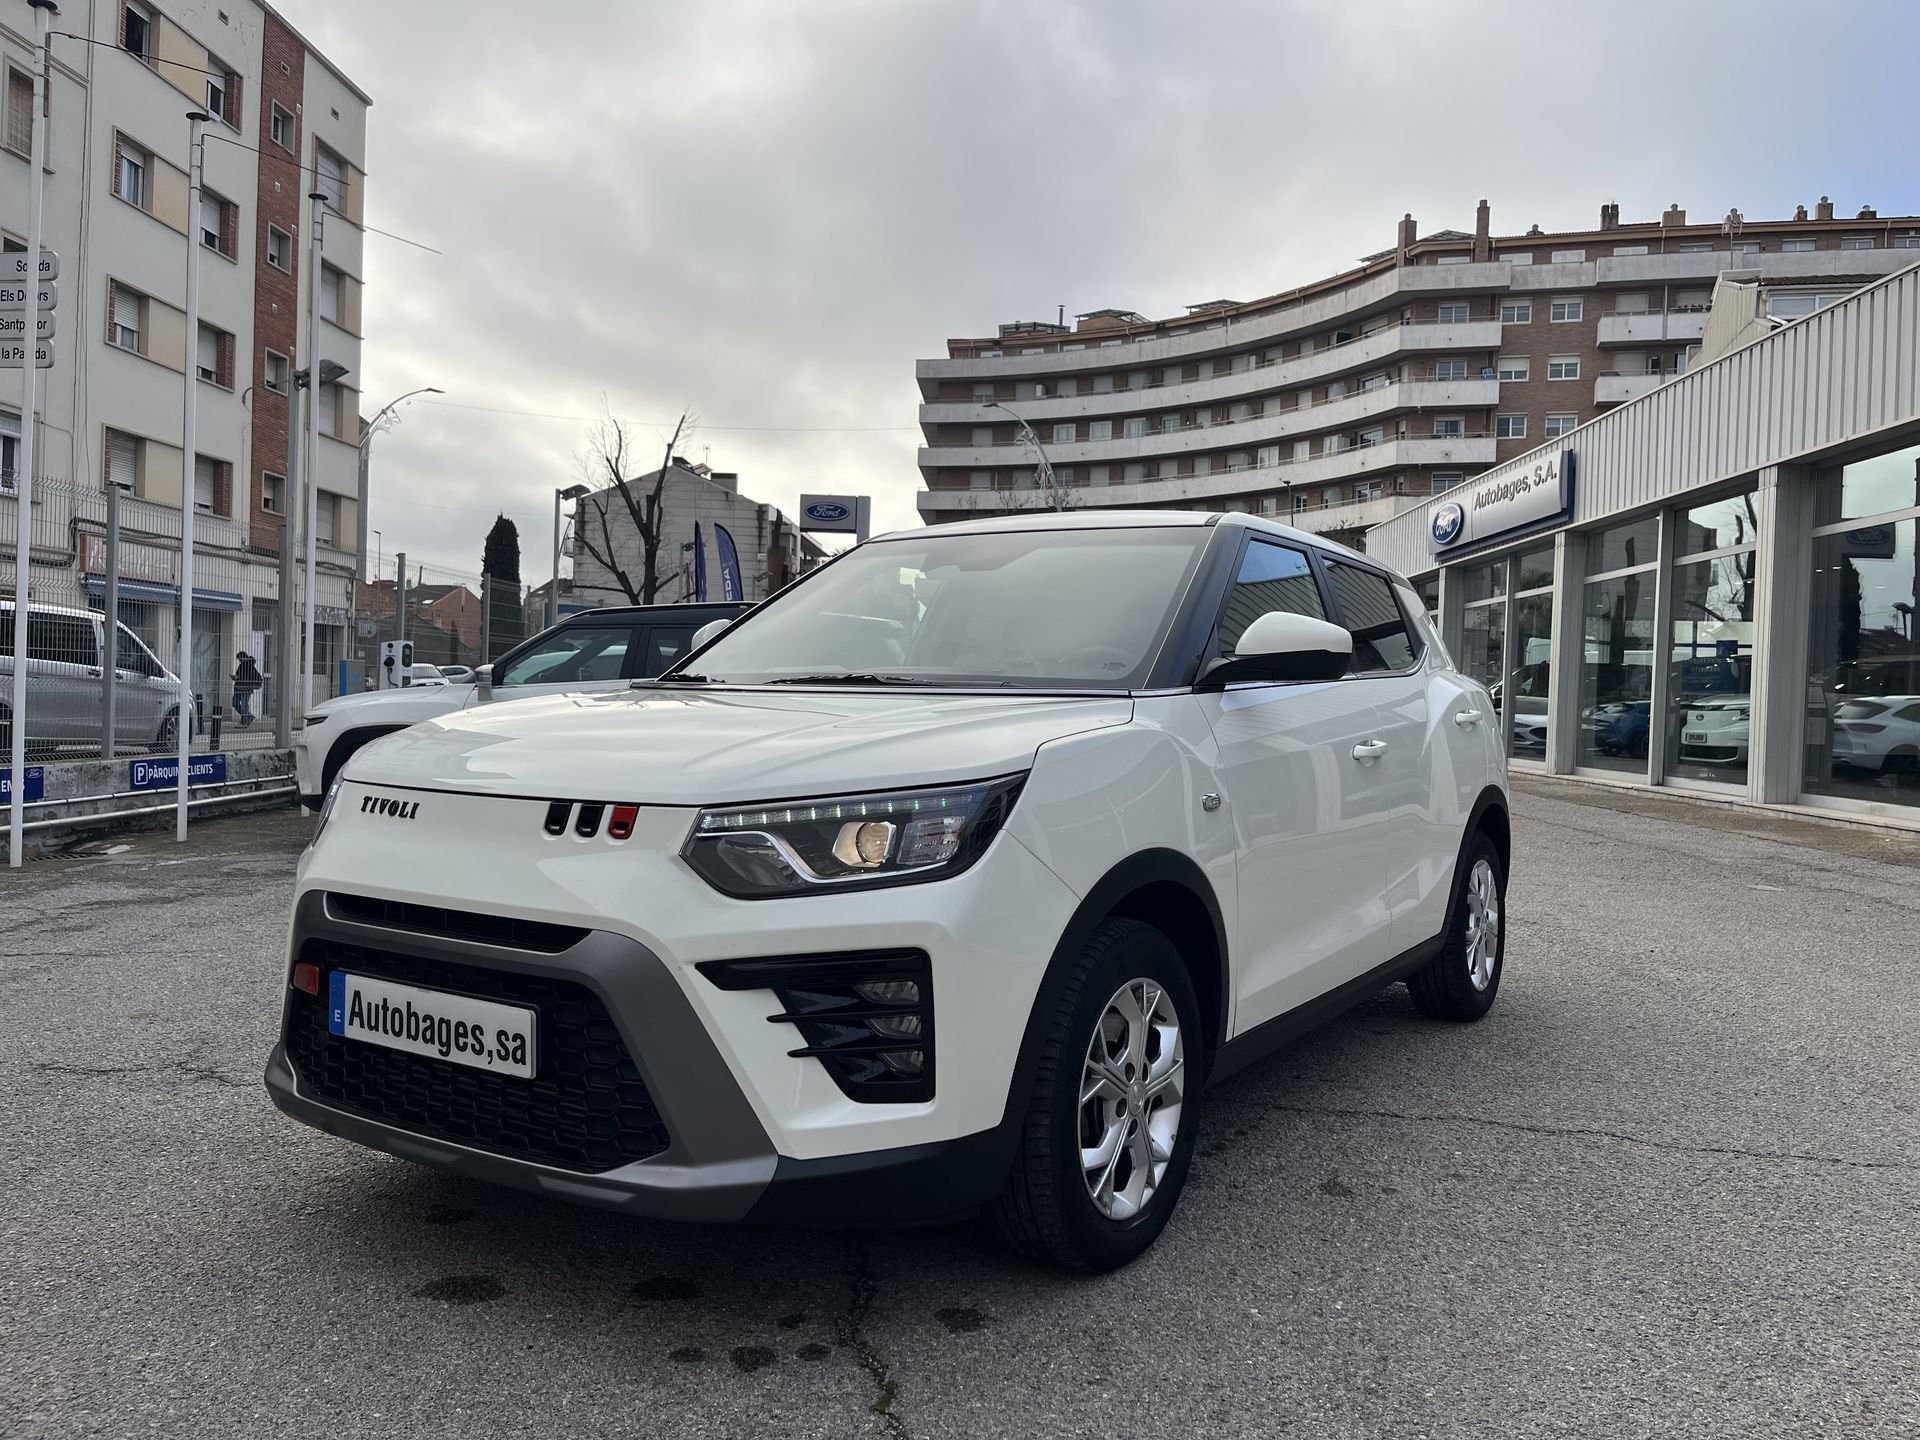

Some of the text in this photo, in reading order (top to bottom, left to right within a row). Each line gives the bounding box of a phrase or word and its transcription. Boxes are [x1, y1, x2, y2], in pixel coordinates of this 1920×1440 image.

[0, 289, 15, 302] Els
[0, 318, 47, 332] Santpor
[1, 347, 46, 360] la Pada
[1473, 460, 1558, 511] Autobages, S.A.
[814, 505, 842, 517] Ford
[148, 765, 180, 779] PÀRQUIN
[360, 795, 420, 819] TIVOLI
[334, 989, 527, 1065] E Autobages,sa
